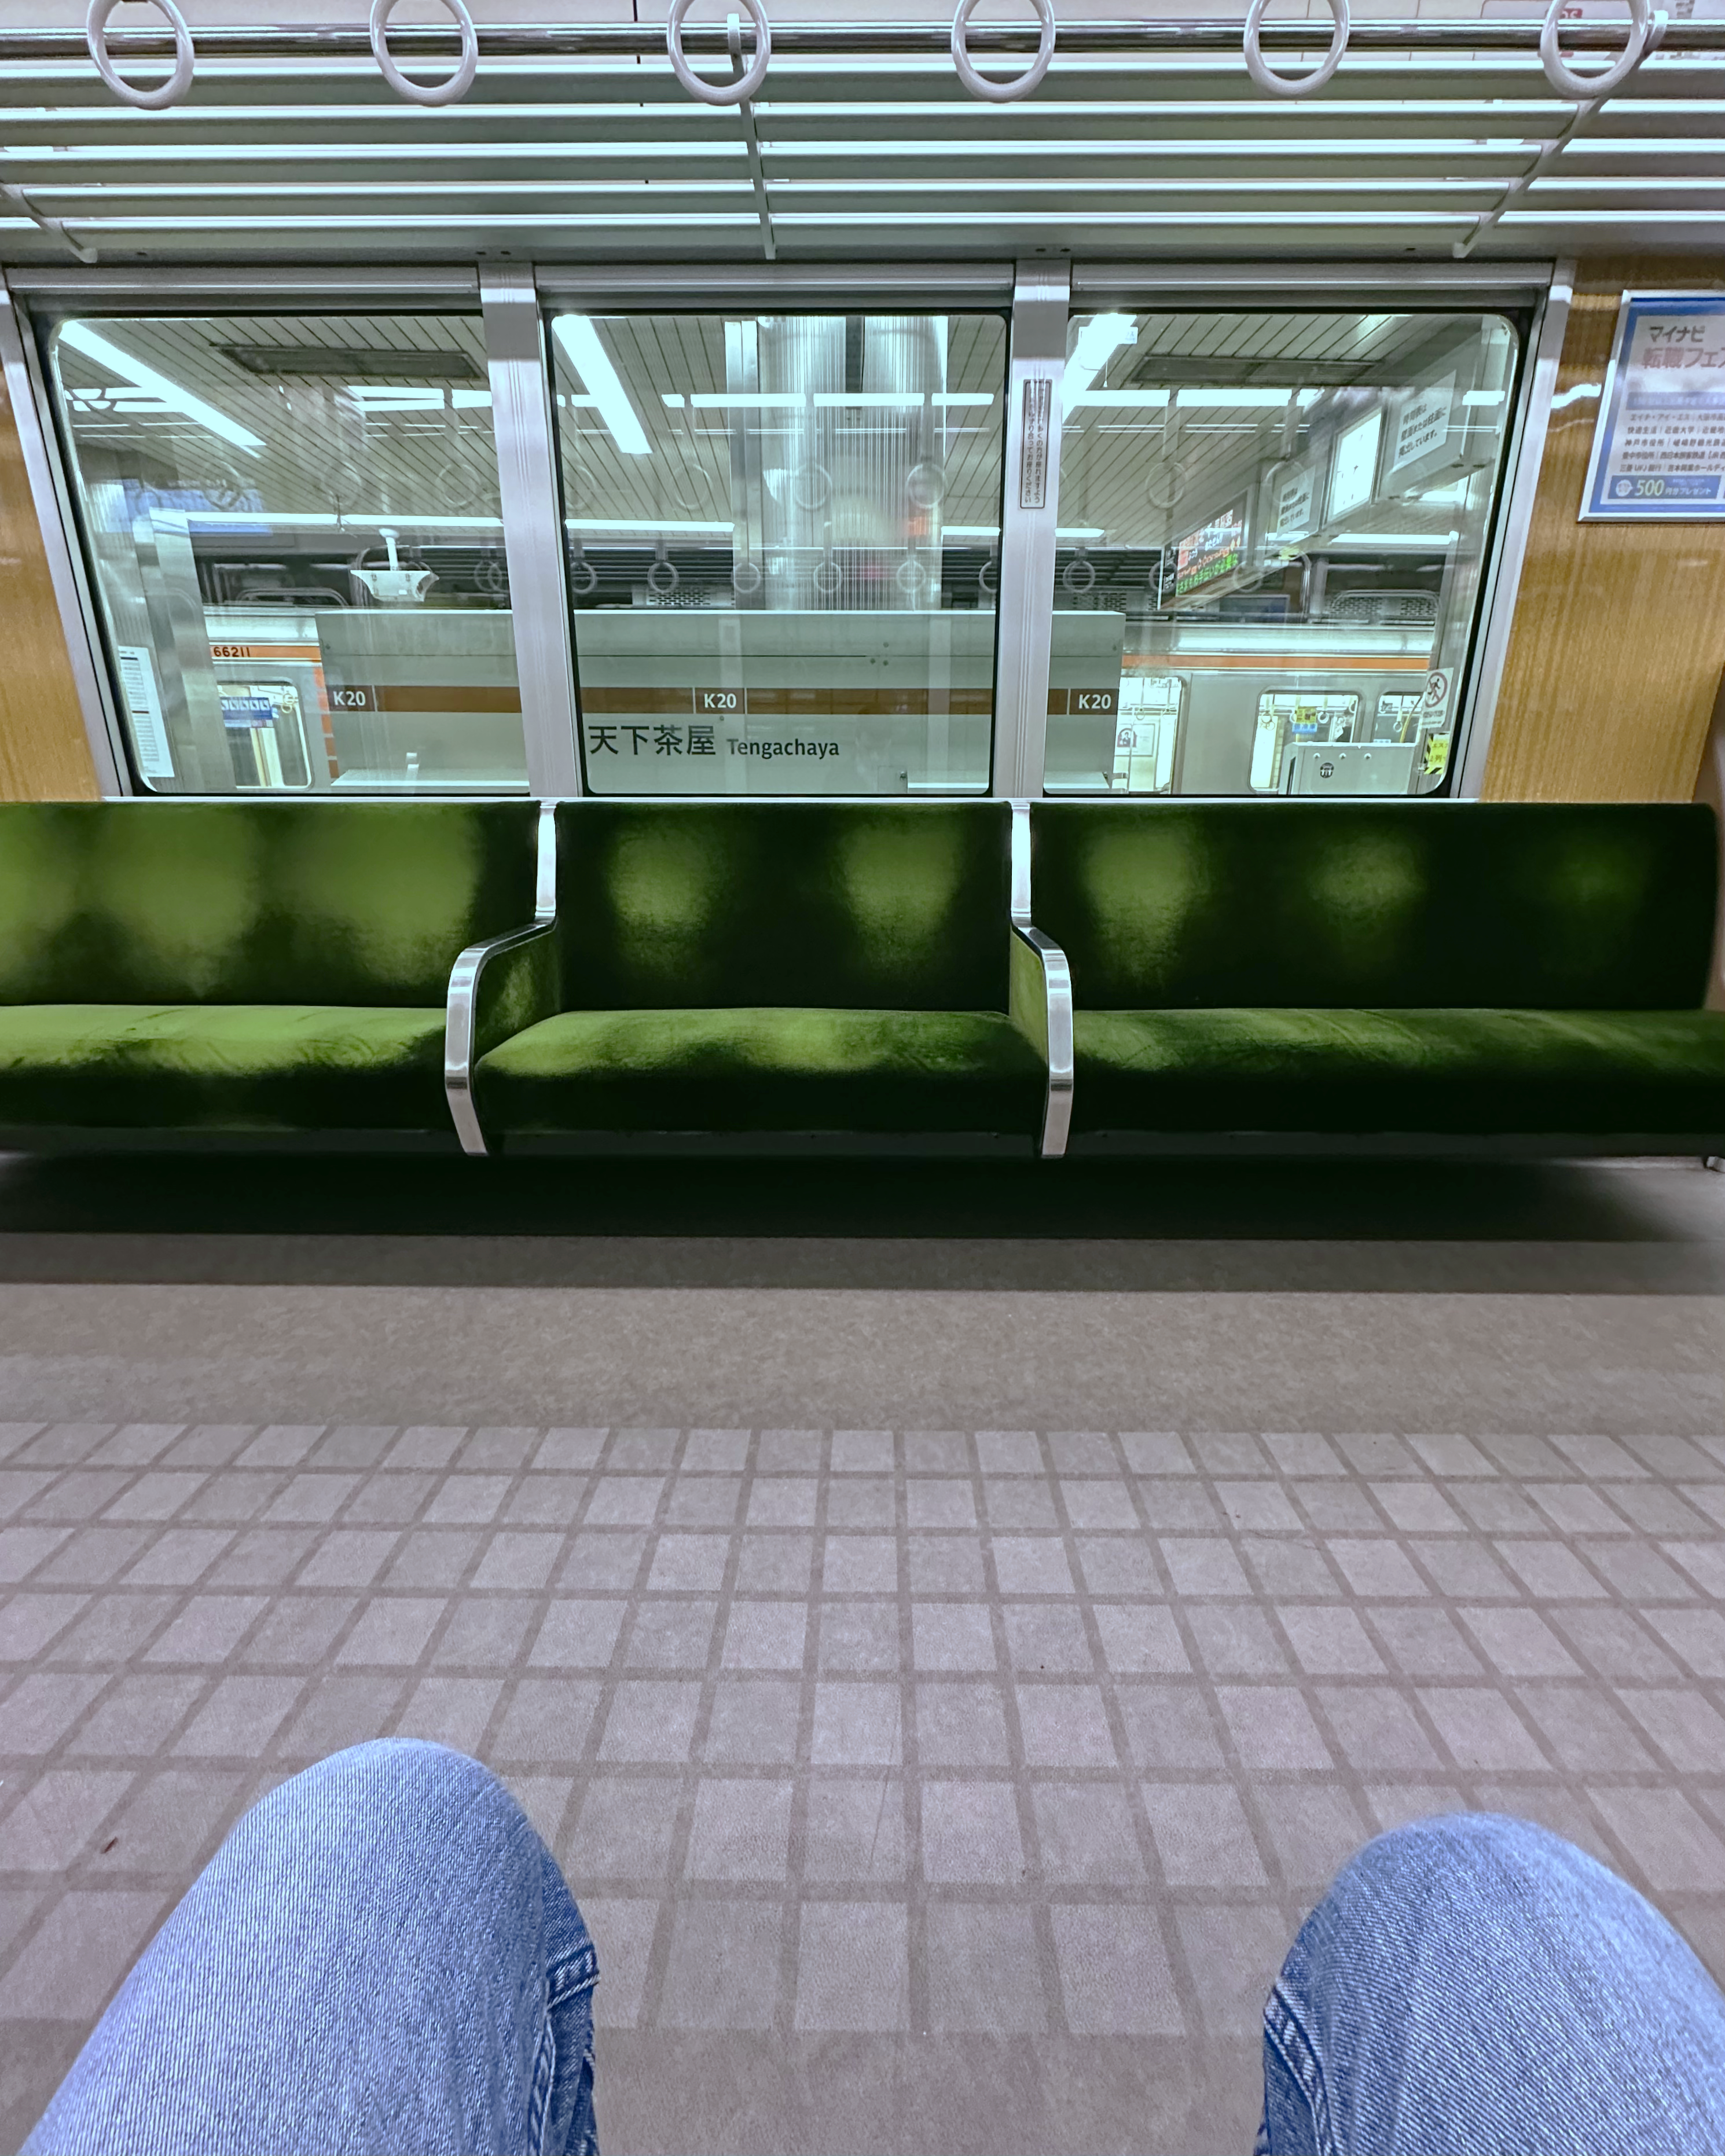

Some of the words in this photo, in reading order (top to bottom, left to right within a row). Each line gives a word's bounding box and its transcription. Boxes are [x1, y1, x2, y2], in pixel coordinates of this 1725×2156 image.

[1650, 325, 1705, 343] マイナビ
[214, 647, 251, 658] 66211
[333, 690, 366, 706] K20
[704, 693, 737, 708] K20
[1078, 694, 1111, 709] K20
[588, 724, 716, 756] 天下茶屋
[726, 738, 839, 759] Tengachaya
